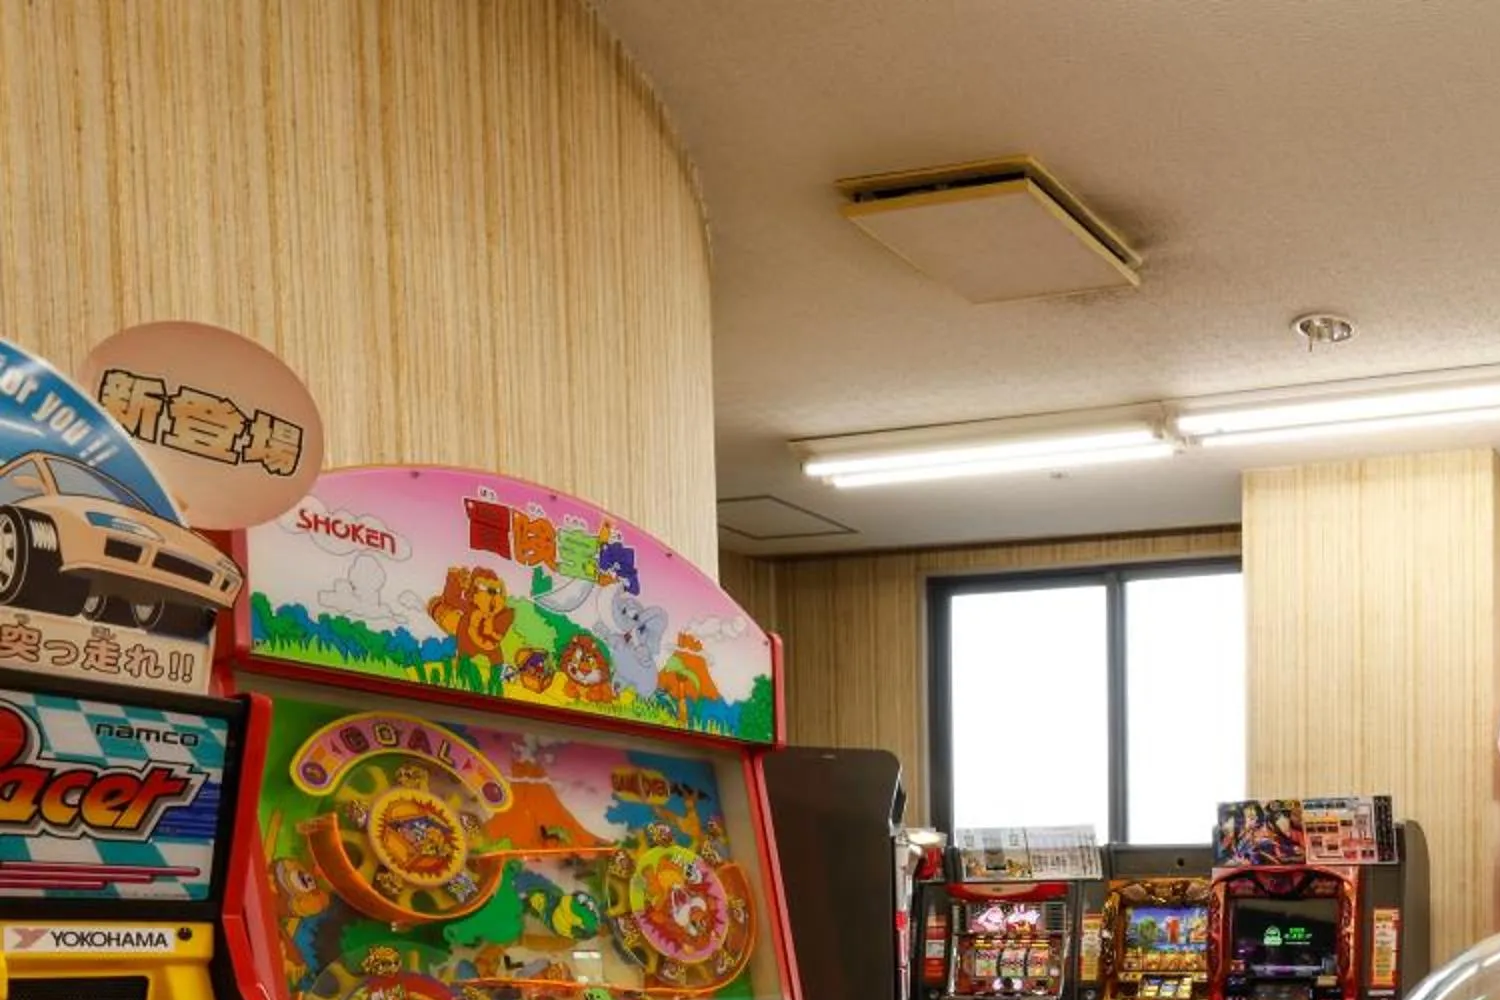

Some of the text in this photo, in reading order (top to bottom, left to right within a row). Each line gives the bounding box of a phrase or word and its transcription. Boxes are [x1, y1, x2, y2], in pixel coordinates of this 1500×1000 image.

[32, 390, 119, 467] you!!
[99, 369, 303, 476] 新登場
[95, 723, 200, 747] namco
[339, 721, 456, 767] GOAL
[50, 930, 169, 949] YOKOHAMA
